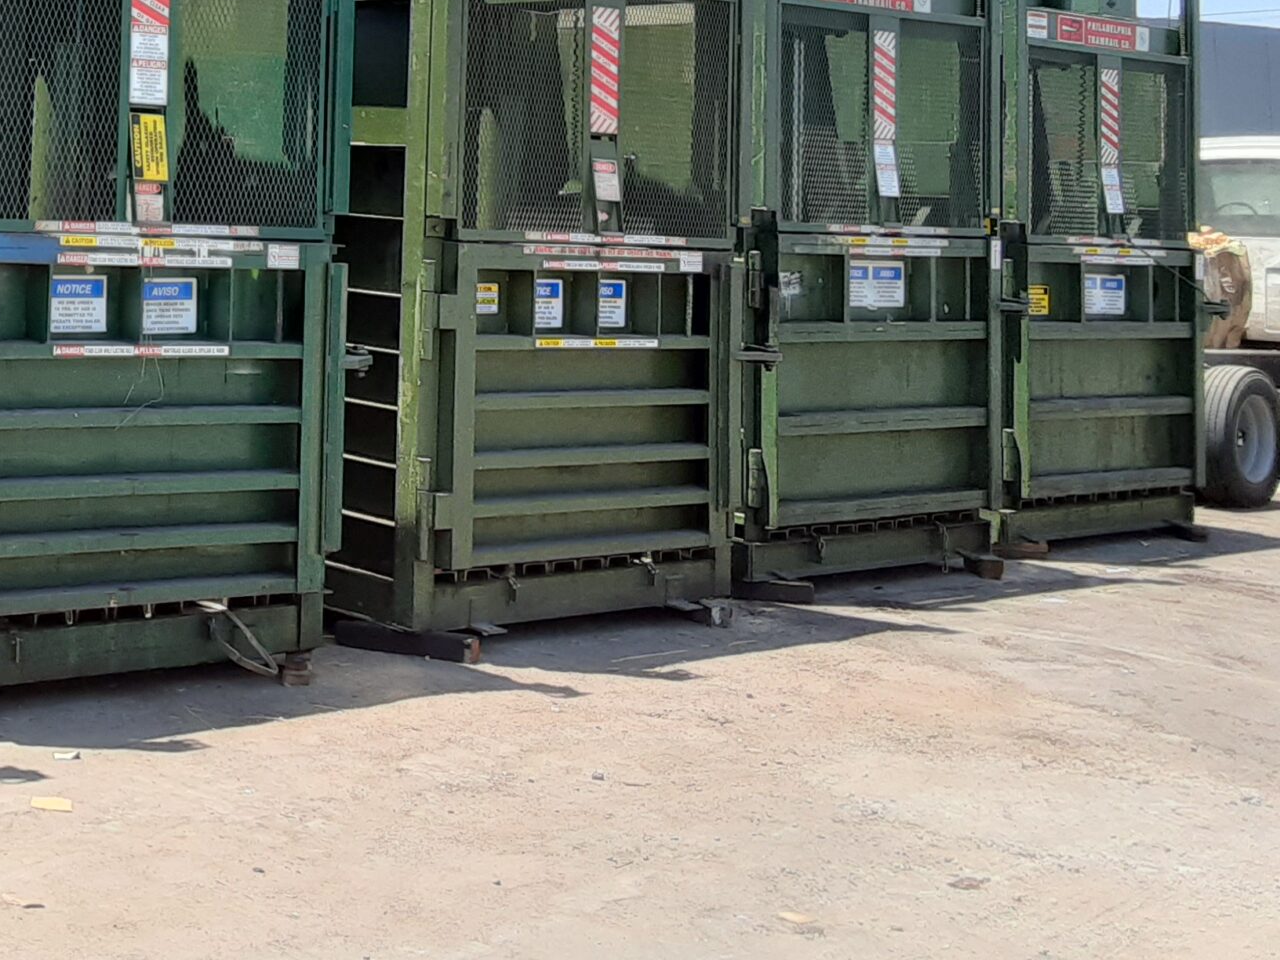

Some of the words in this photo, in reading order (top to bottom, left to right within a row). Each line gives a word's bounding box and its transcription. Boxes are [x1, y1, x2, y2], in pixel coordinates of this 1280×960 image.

[133, 124, 142, 168] CAUTION
[56, 284, 93, 295] NOTICE
[151, 286, 180, 296] AVISO
[536, 286, 552, 296] TICE
[599, 286, 614, 296] ISO
